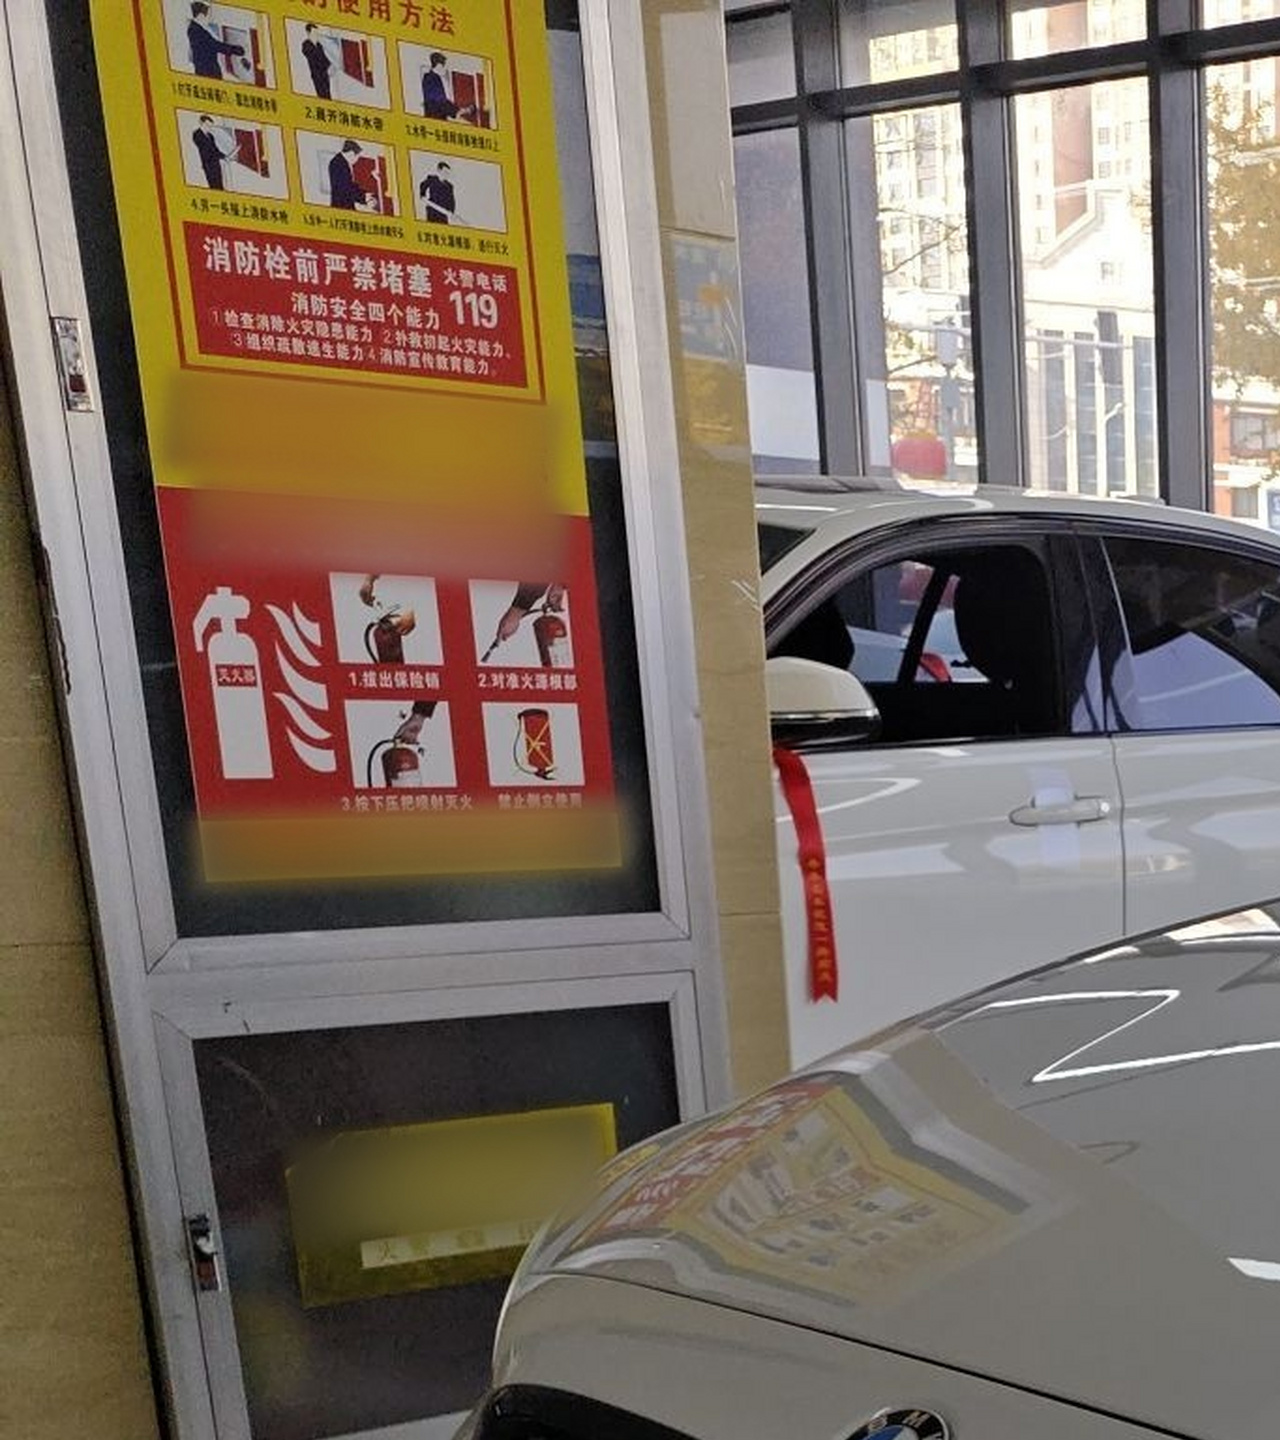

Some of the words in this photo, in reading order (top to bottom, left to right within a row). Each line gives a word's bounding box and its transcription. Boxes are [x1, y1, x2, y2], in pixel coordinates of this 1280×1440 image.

[203, 235, 433, 299] 消防栓前严禁堵塞
[443, 267, 508, 294] 火警电话
[291, 291, 440, 331] 消防安全四个能力
[449, 291, 499, 329] 119
[348, 671, 441, 689] 1.拔出保险销
[477, 673, 578, 691] 2.对准火源根部
